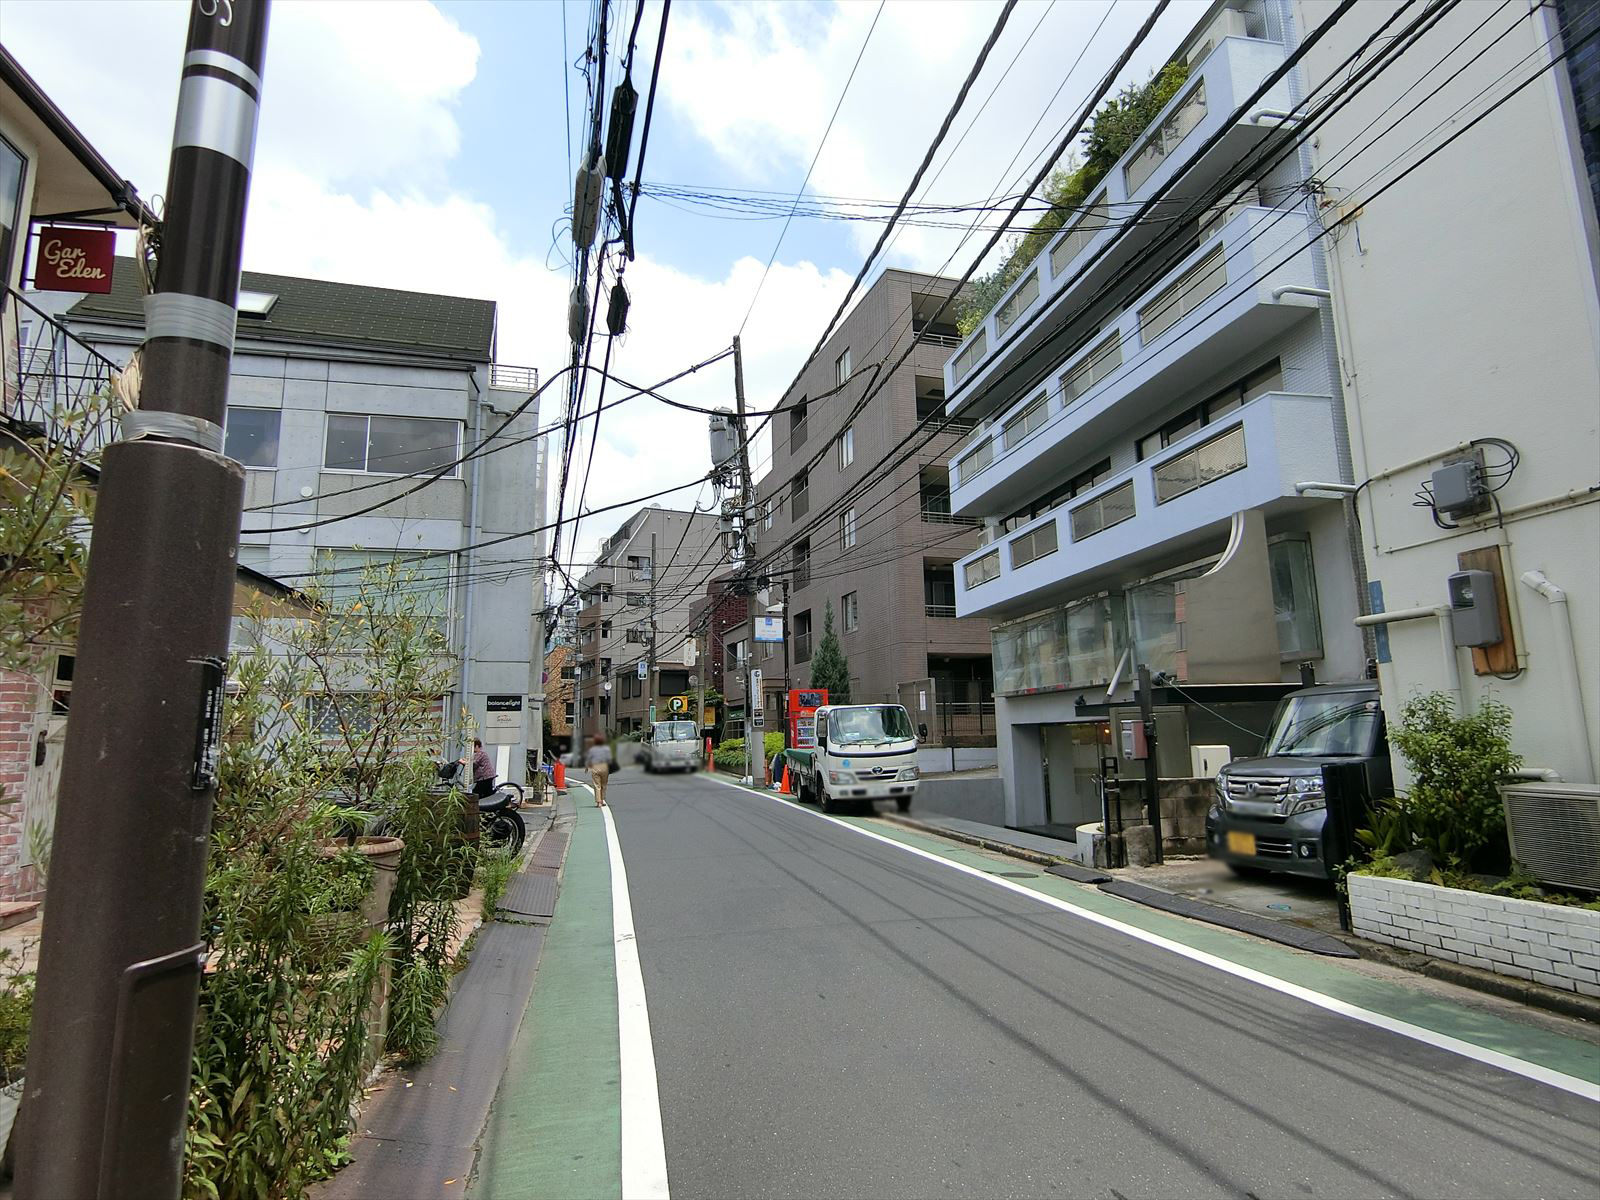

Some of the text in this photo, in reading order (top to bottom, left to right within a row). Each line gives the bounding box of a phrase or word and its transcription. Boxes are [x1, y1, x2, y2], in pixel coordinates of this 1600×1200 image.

[44, 239, 86, 265] Gar
[56, 258, 106, 279] Eden
[673, 699, 682, 711] P
